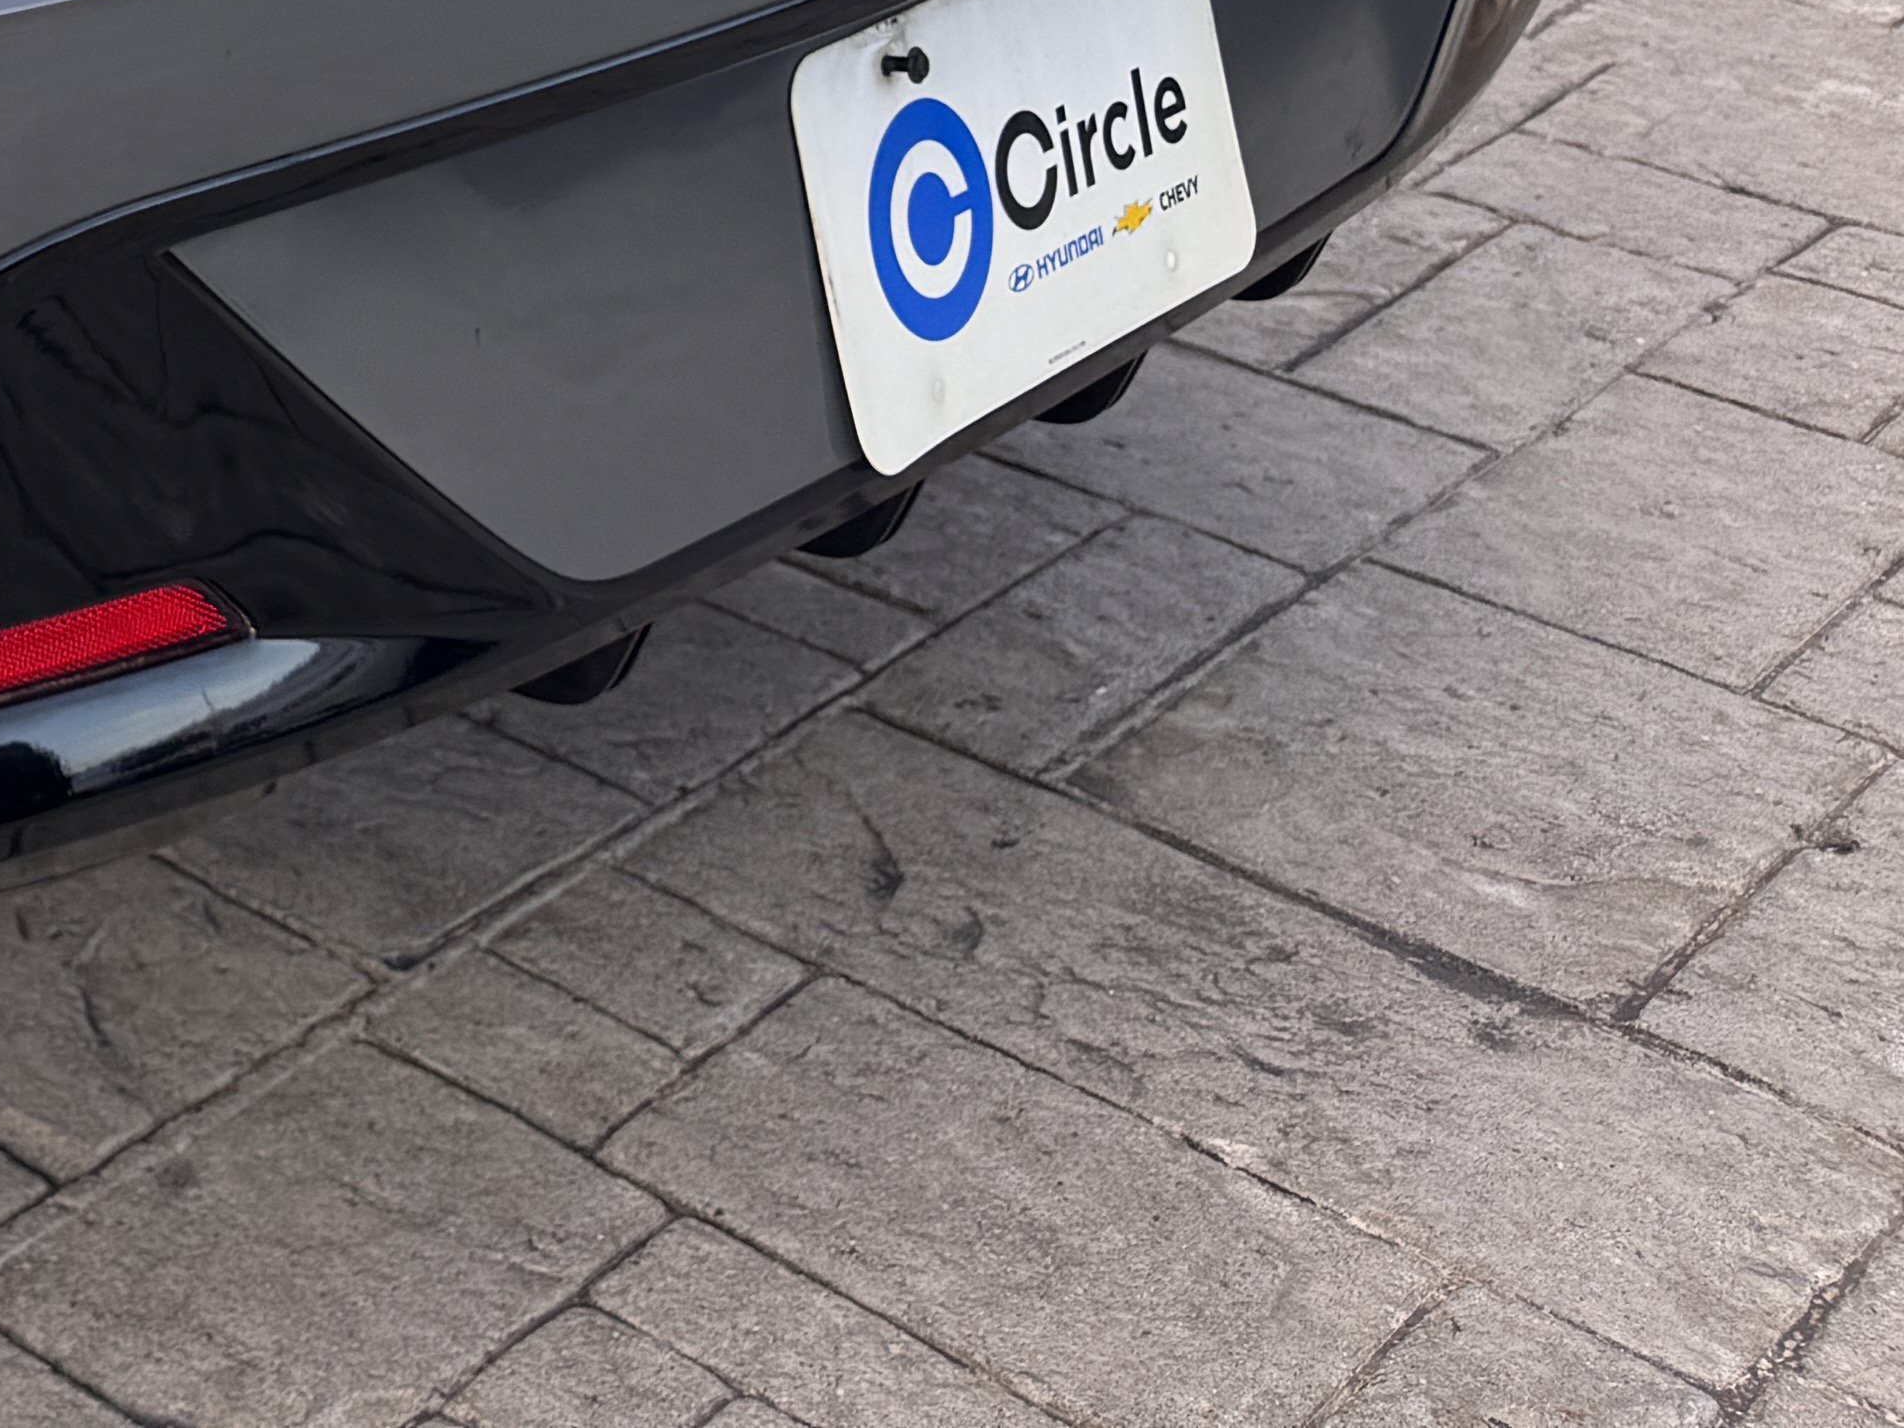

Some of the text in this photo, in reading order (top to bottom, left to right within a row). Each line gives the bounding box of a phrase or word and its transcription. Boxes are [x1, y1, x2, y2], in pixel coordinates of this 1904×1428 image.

[994, 67, 1188, 231] Circle
[1036, 175, 1199, 279] HYUNDAI CHEVY
